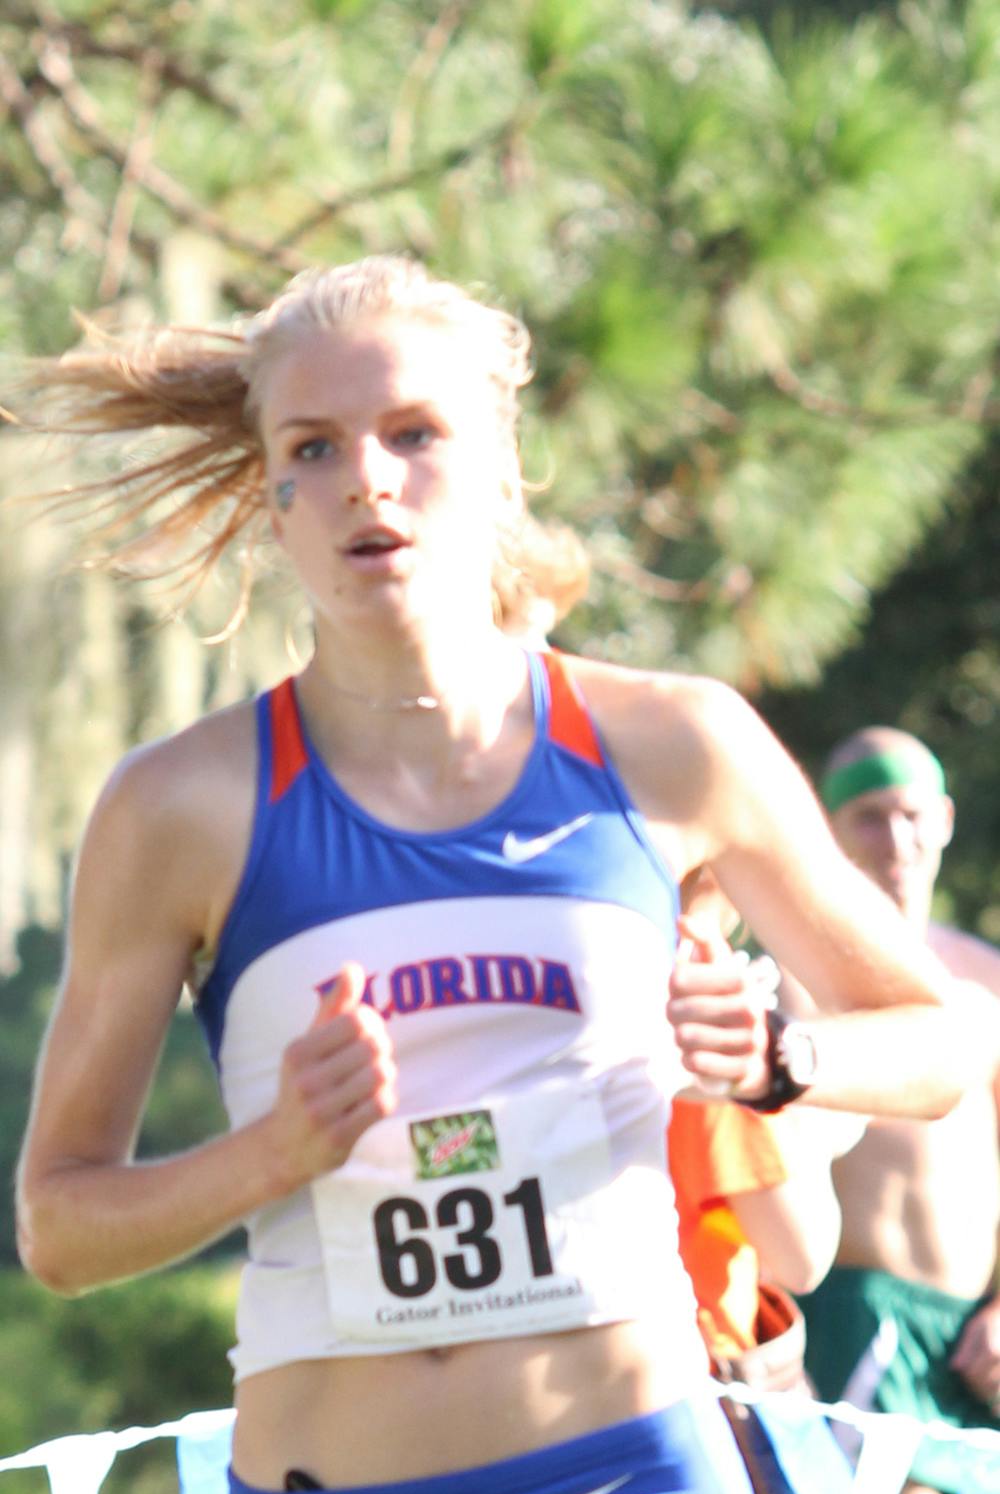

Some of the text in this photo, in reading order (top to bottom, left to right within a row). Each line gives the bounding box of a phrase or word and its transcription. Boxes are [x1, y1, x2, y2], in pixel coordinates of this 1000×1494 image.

[314, 953, 582, 1020] ORIDA
[373, 1177, 554, 1299] 631
[376, 1305, 441, 1326] Gator
[448, 1279, 584, 1317] Invitational
